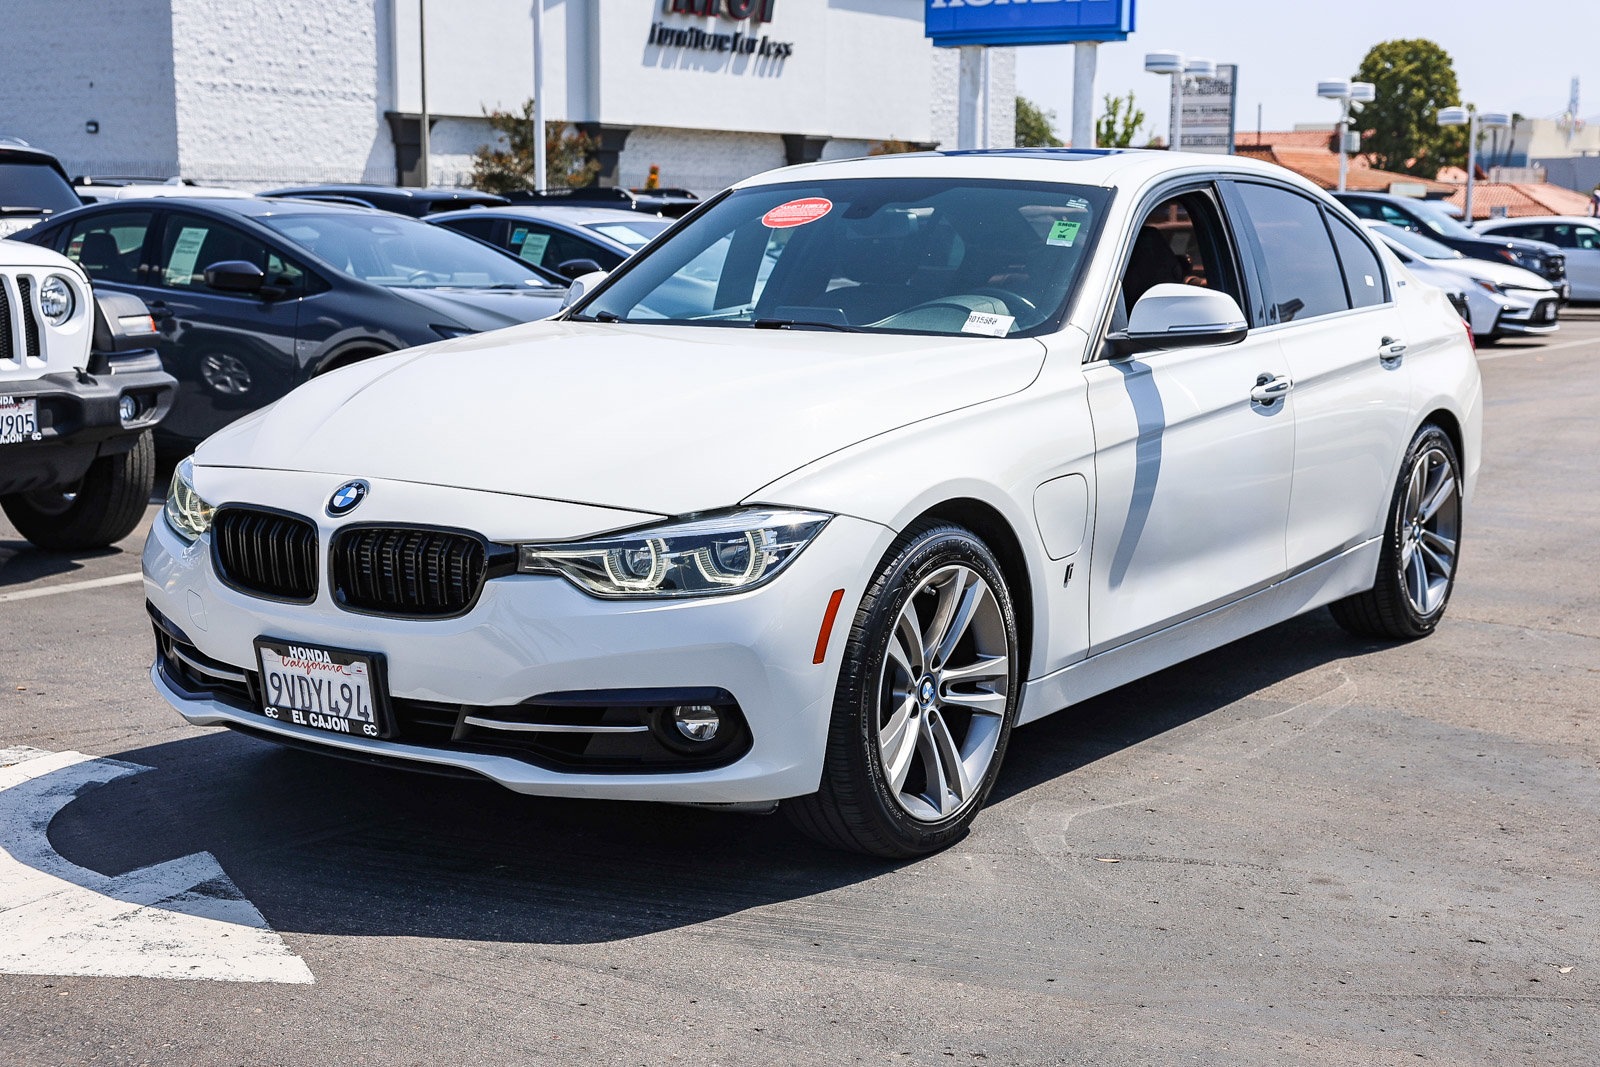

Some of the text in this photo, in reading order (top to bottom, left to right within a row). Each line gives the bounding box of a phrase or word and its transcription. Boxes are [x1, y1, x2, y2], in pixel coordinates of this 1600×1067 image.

[288, 646, 332, 664] HONDA
[269, 672, 370, 722] 9VDY494
[291, 710, 350, 733] EL CAJON
